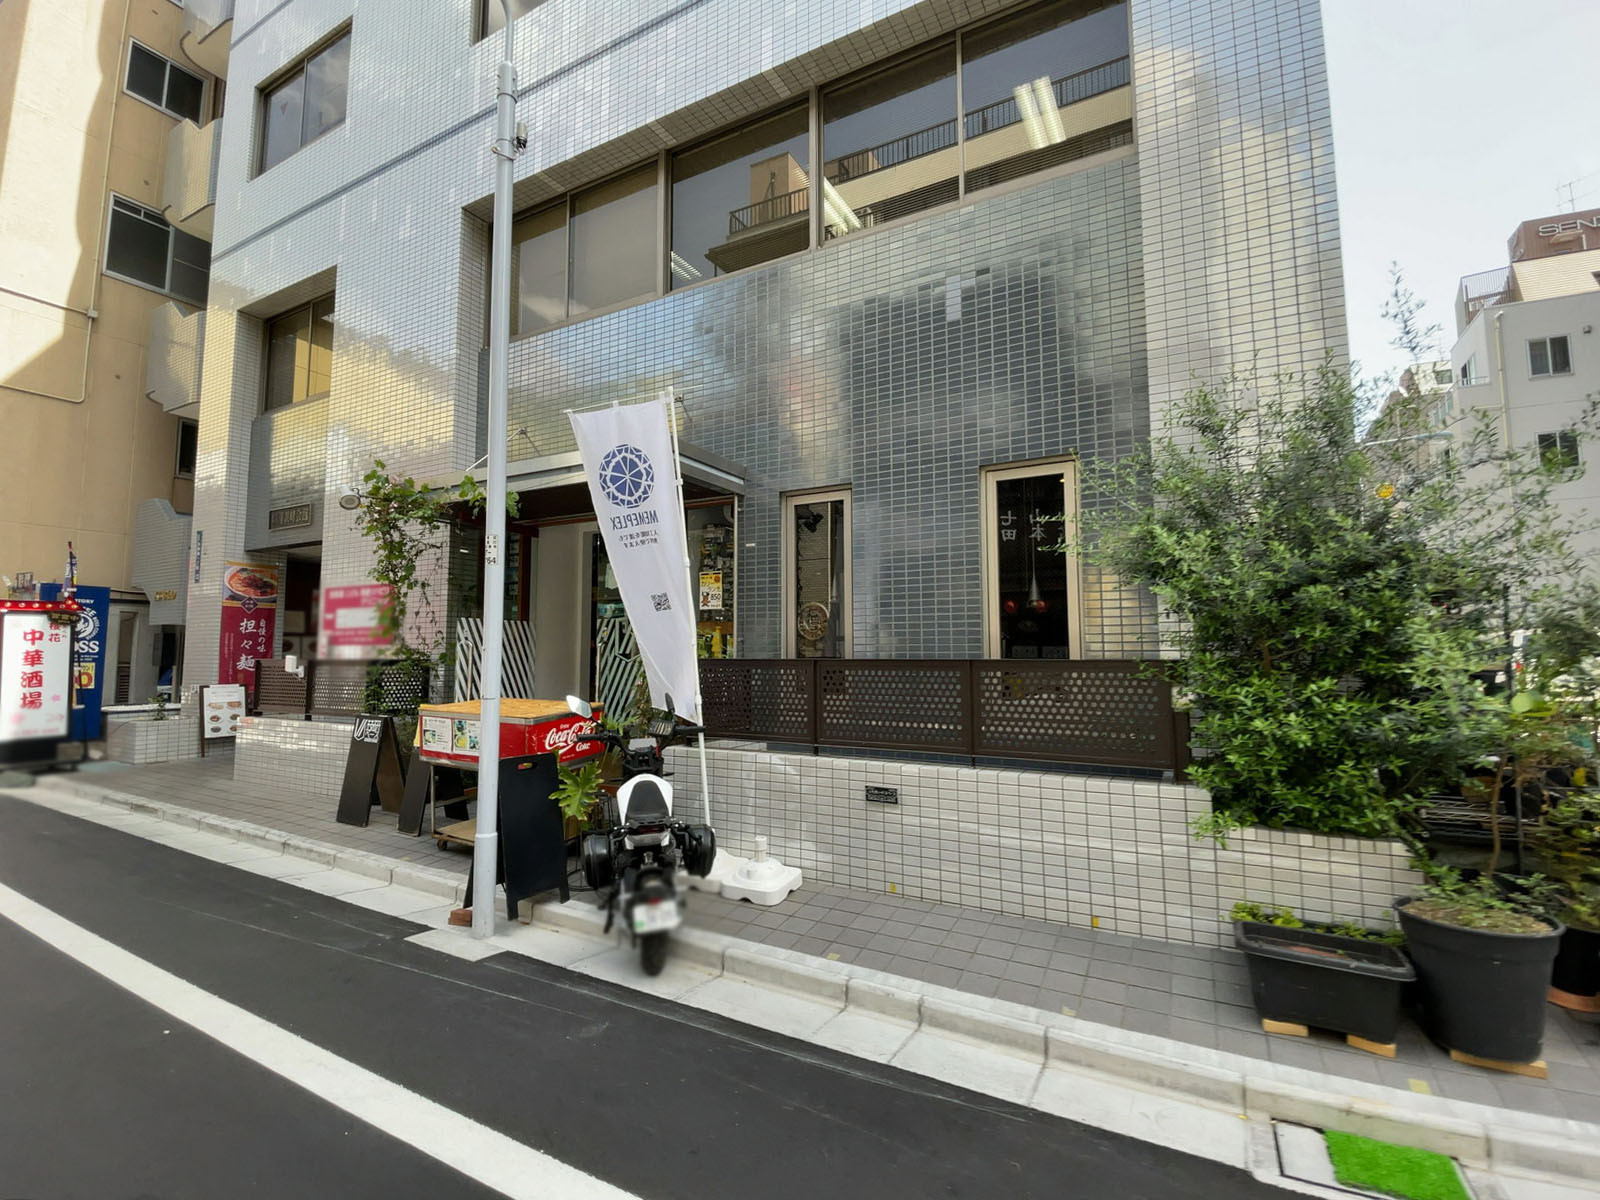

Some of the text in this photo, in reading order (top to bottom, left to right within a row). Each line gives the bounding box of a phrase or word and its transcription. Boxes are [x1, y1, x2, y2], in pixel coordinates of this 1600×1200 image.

[1538, 216, 1600, 237] SEN
[74, 640, 100, 653] SS
[20, 629, 45, 710] 中華酒場
